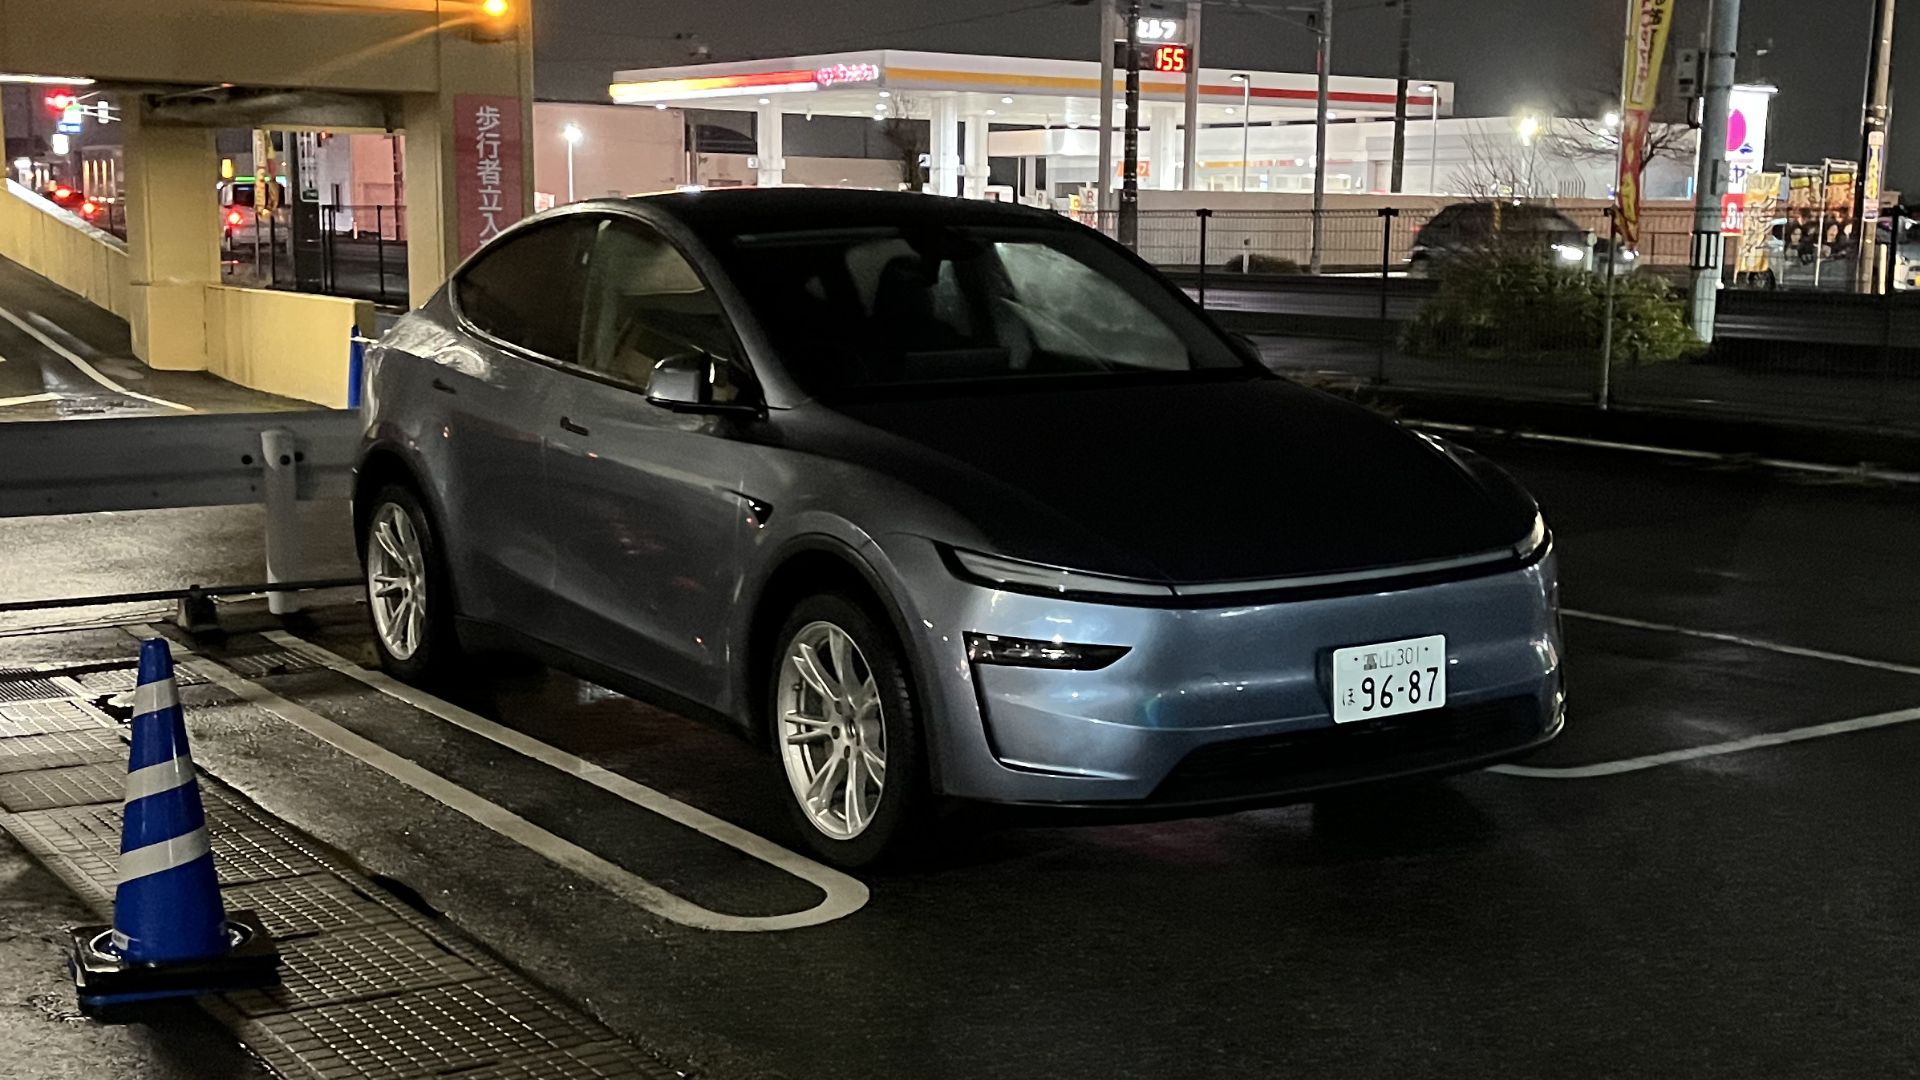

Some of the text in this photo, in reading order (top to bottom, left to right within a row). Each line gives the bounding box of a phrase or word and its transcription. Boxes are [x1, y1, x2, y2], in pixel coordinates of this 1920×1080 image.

[1156, 48, 1184, 71] 155
[475, 105, 503, 245] 歩行者立入
[1361, 667, 1439, 712] 96-87
